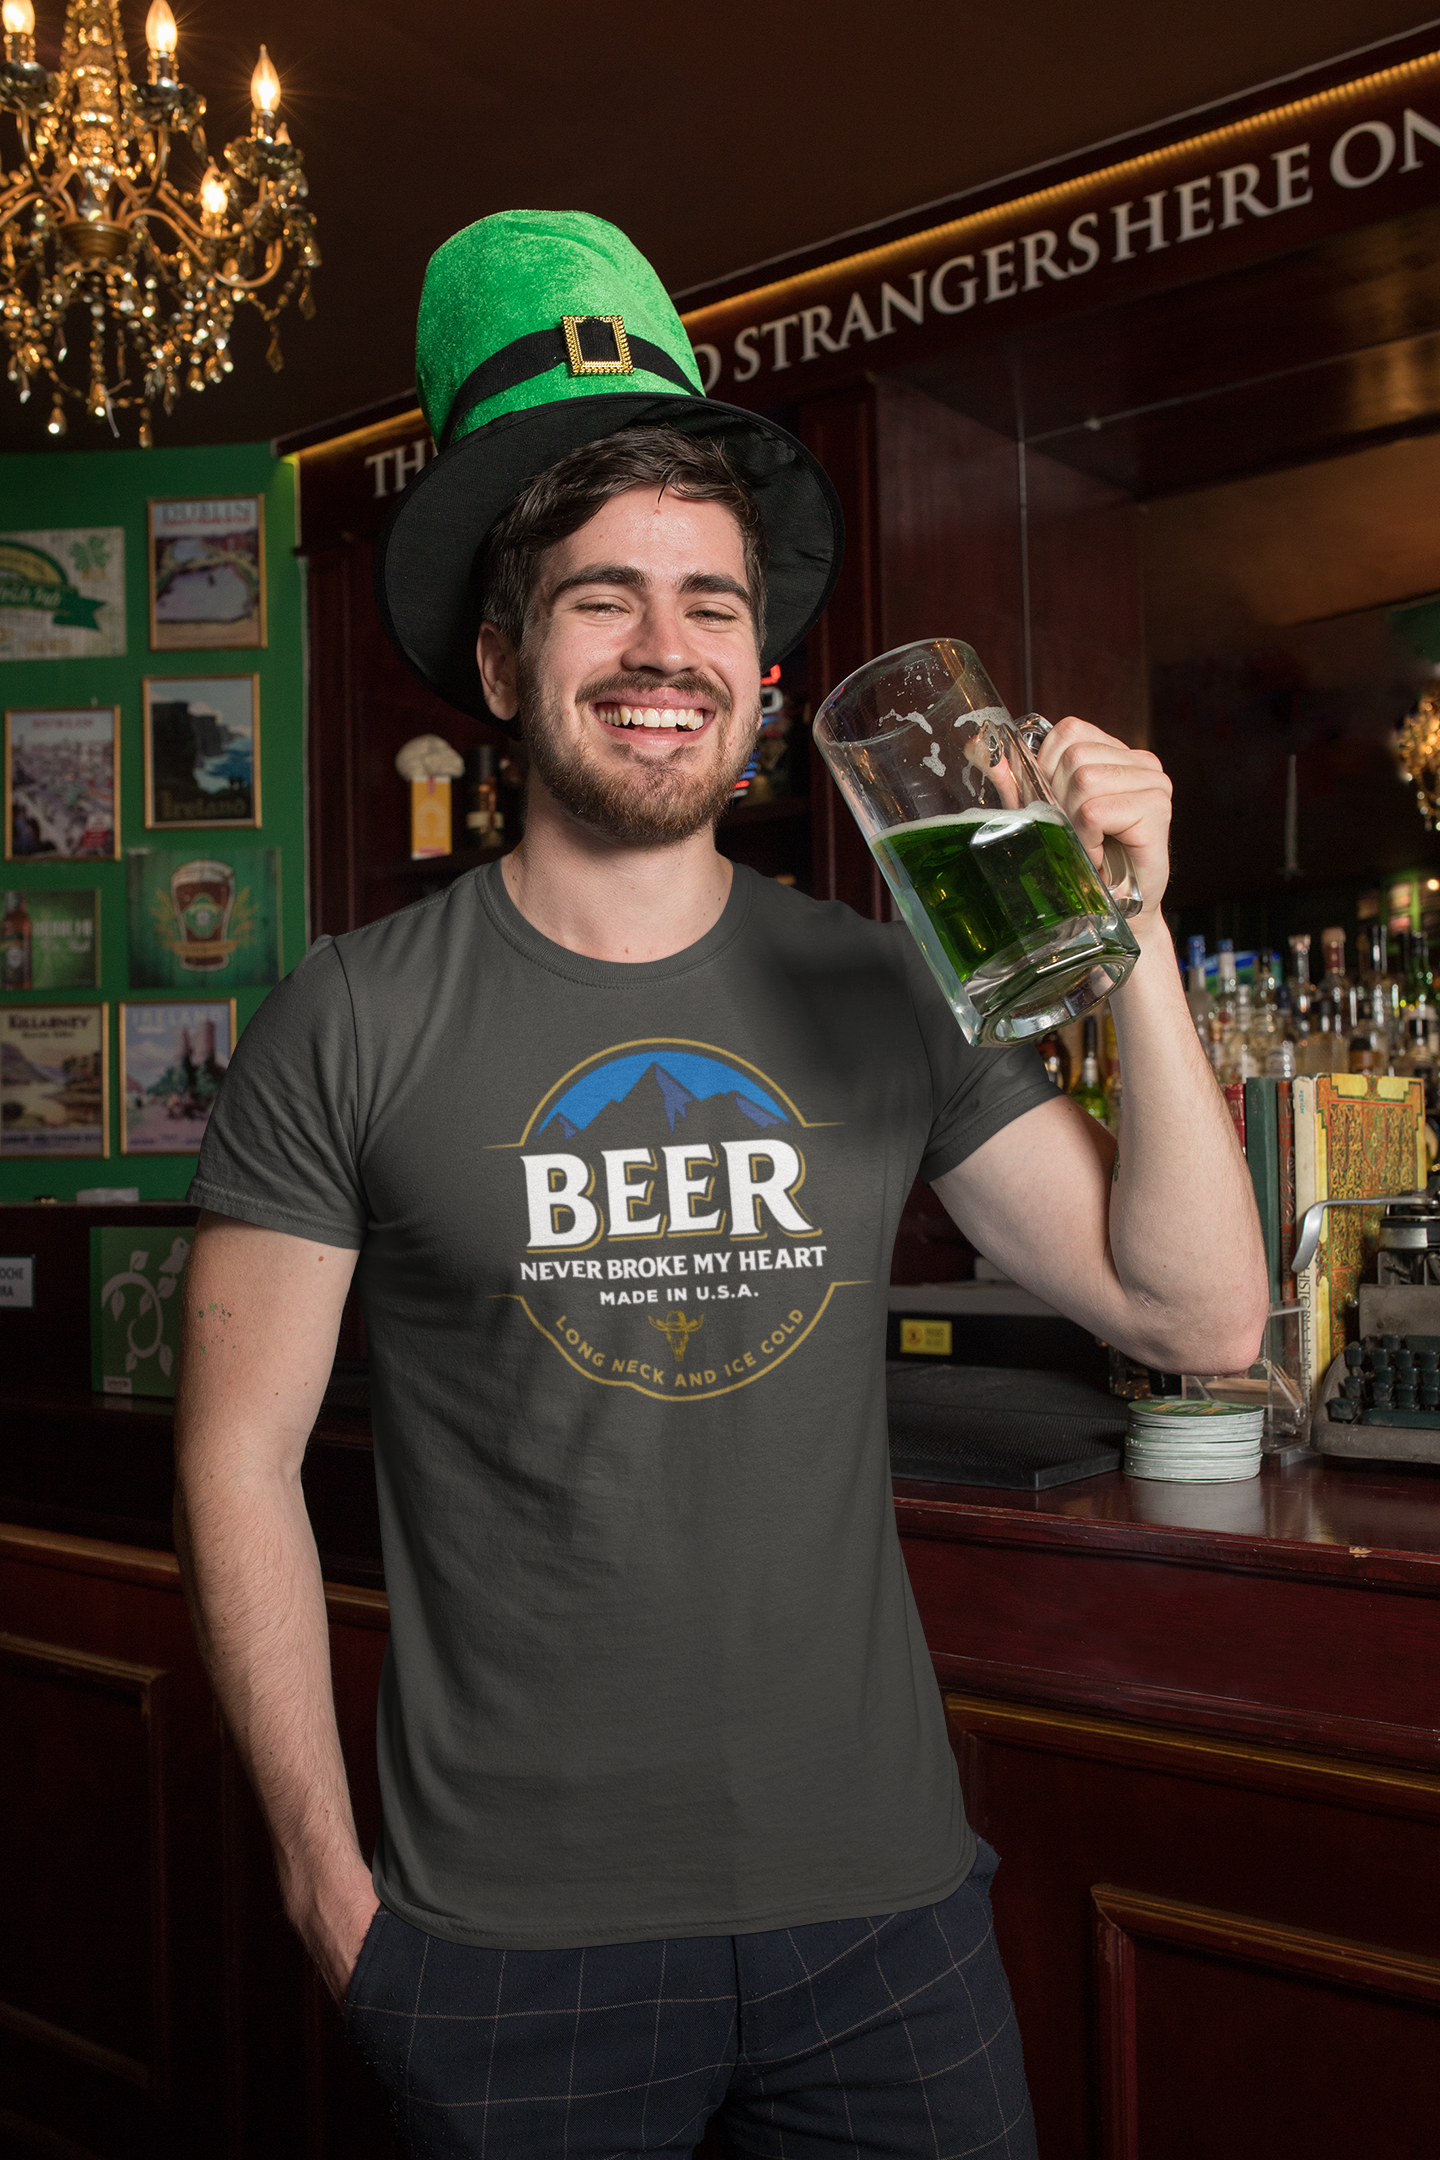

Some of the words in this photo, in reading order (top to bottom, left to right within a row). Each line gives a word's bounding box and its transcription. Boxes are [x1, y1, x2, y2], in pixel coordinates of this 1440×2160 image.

[364, 436, 439, 499] TH
[733, 212, 1101, 383] STRANGERS
[1109, 142, 1314, 264] HERE
[520, 1138, 822, 1252] BEER
[520, 1260, 604, 1282] NEVER
[607, 1254, 688, 1280] BROKE
[693, 1252, 732, 1275] MY
[738, 1245, 827, 1272] HEART
[600, 1289, 659, 1306] MADE
[667, 1287, 688, 1302] IN
[696, 1283, 759, 1301] U.S.A.
[555, 1315, 605, 1367] LONG
[612, 1359, 665, 1386] NECK
[674, 1369, 717, 1388] AND
[724, 1352, 757, 1378] ICE
[760, 1309, 804, 1355] COLD
